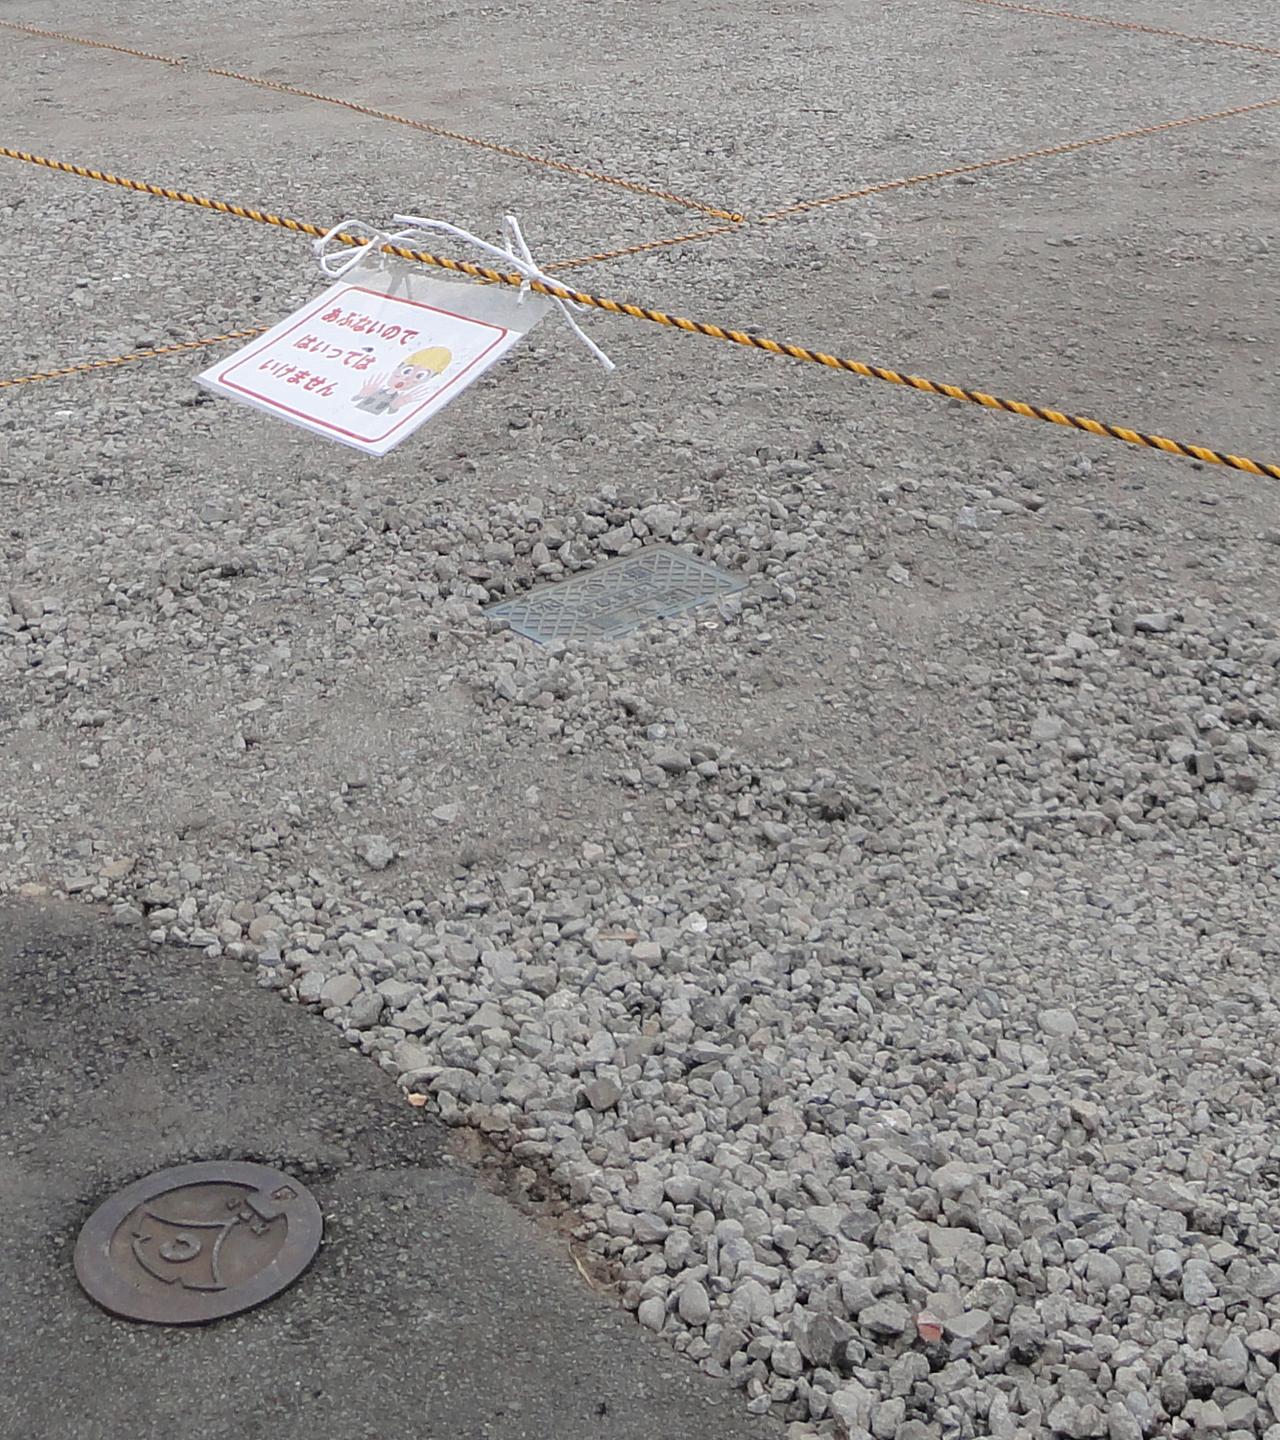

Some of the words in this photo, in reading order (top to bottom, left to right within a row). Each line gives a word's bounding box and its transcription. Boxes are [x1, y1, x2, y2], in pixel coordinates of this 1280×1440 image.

[321, 307, 420, 345] あぶないので
[293, 334, 376, 370] はいっては
[258, 359, 339, 397] いけません
